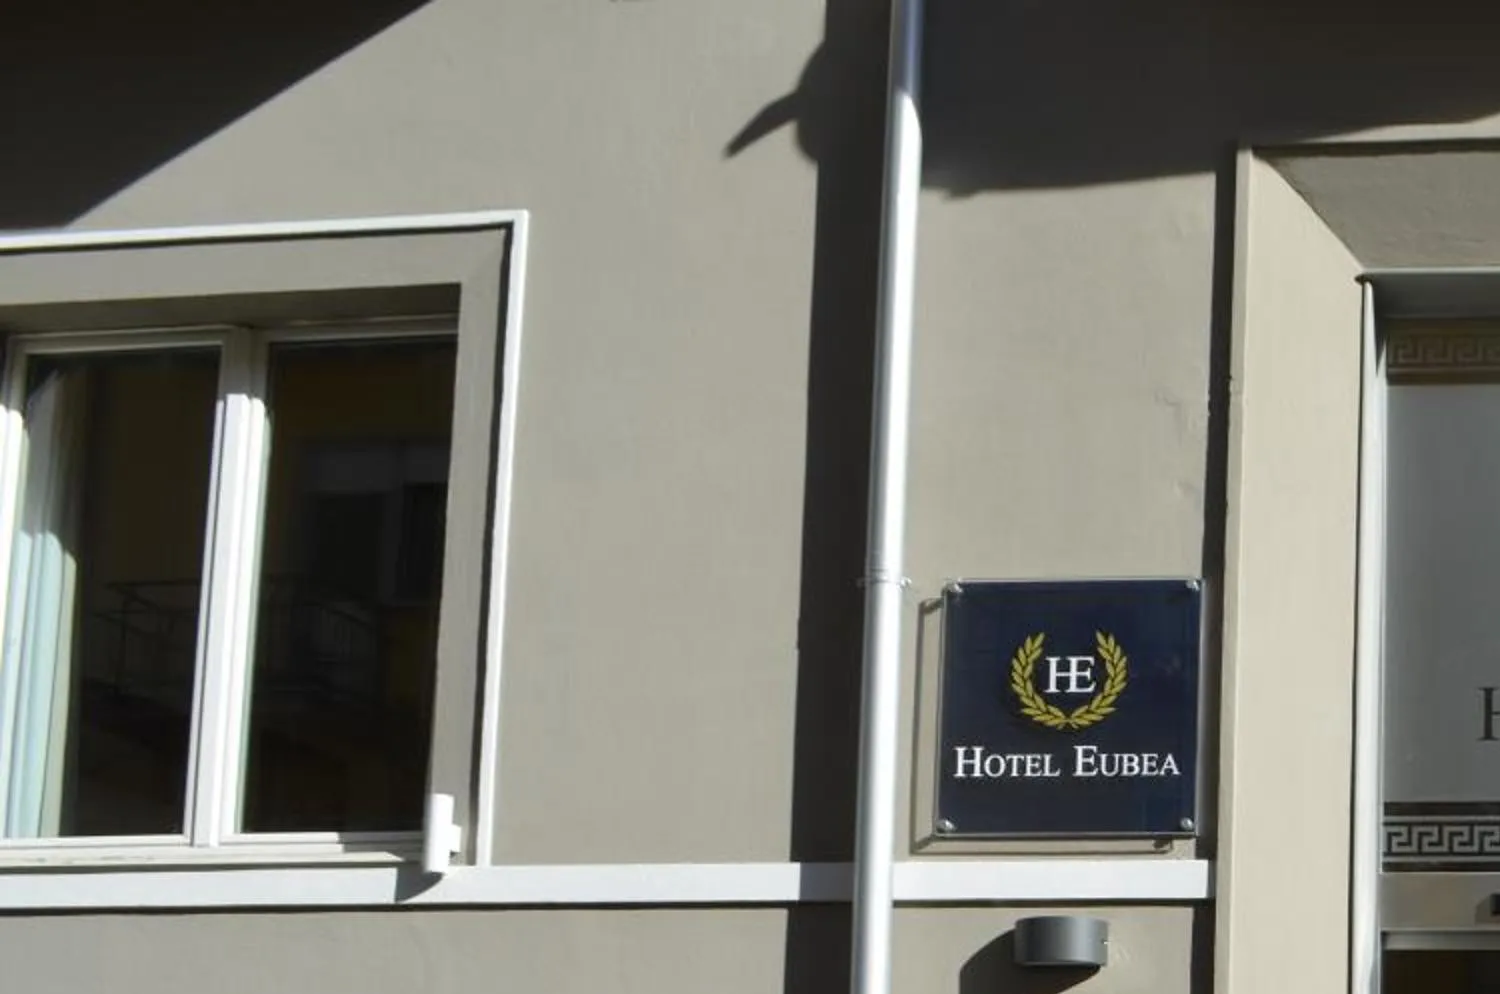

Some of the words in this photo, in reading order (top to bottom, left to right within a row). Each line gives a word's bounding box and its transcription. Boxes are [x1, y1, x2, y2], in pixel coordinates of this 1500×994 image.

[1044, 656, 1097, 693] HE
[953, 746, 1061, 778] HOTEL
[1072, 745, 1181, 778] EUBEA
